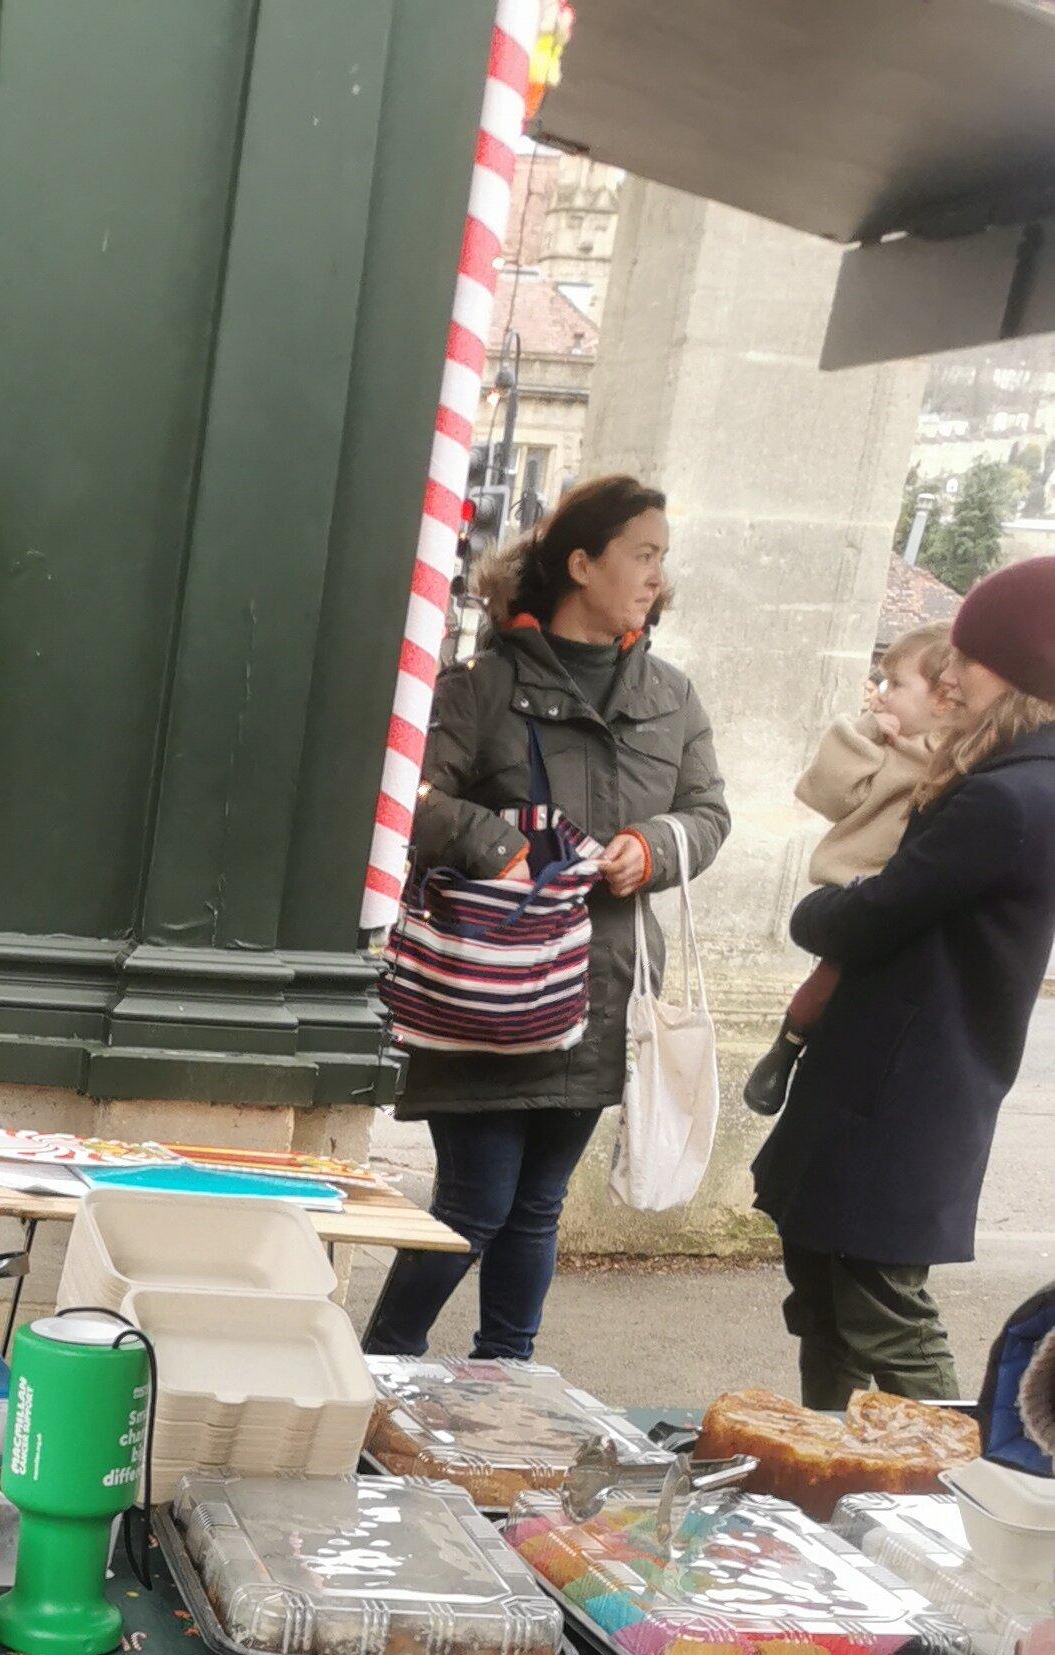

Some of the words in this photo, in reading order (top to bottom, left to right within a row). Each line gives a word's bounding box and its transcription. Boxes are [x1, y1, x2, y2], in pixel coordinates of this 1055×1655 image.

[10, 1376, 27, 1475] MACMILLAN
[17, 1434, 29, 1475] CANCER
[23, 1385, 34, 1433] SUPPORT
